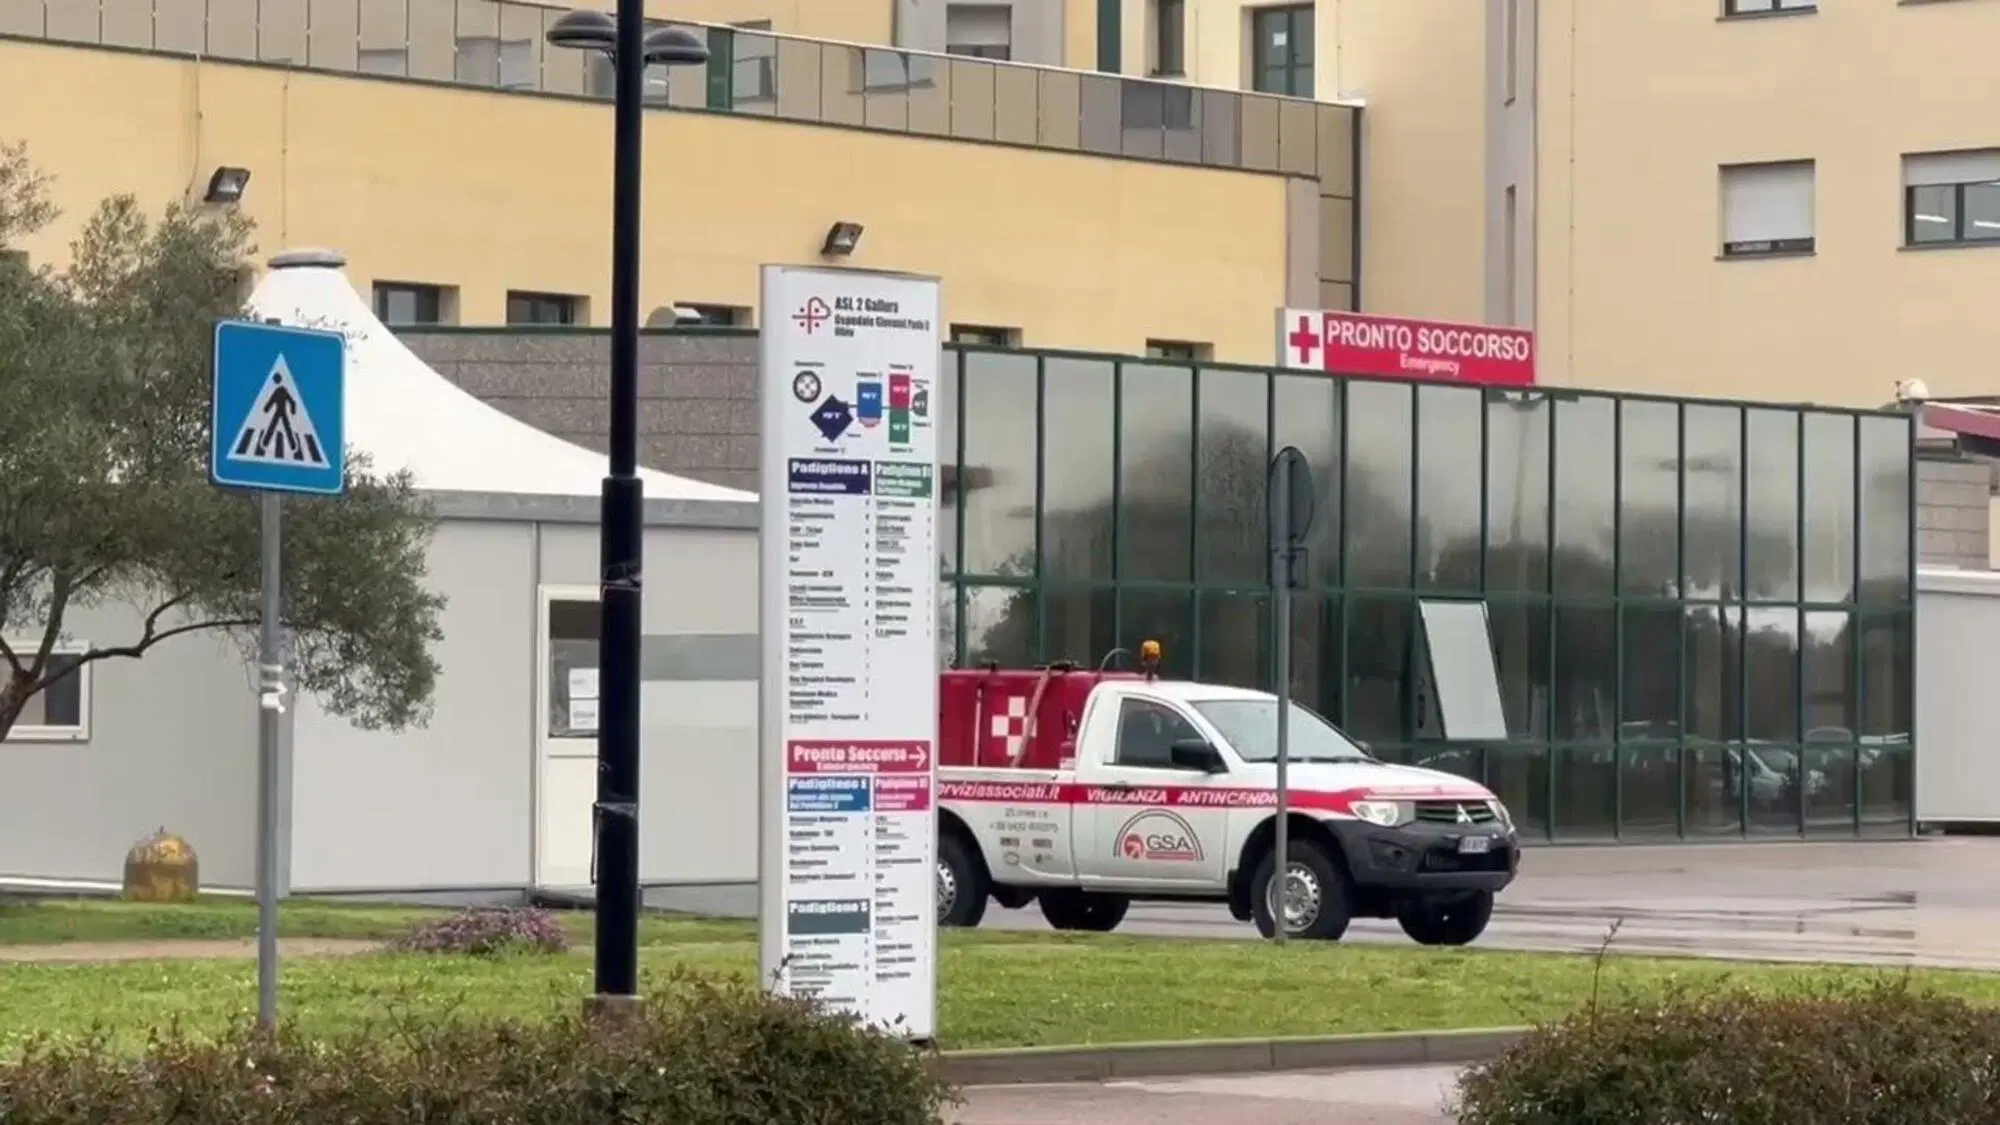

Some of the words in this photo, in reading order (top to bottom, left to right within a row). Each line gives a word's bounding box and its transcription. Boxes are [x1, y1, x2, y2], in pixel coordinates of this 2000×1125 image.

[834, 297, 854, 310] ASL
[856, 298, 863, 310] 2
[1326, 320, 1413, 350] PRONTO
[1417, 328, 1530, 361] SOCCORSO
[1400, 353, 1461, 375] Emergency
[791, 462, 860, 475] Padiglione
[793, 745, 846, 762] Pronto
[847, 745, 908, 761] Soccorso
[1086, 787, 1168, 803] VIGILANZA
[1146, 834, 1191, 851] GSA
